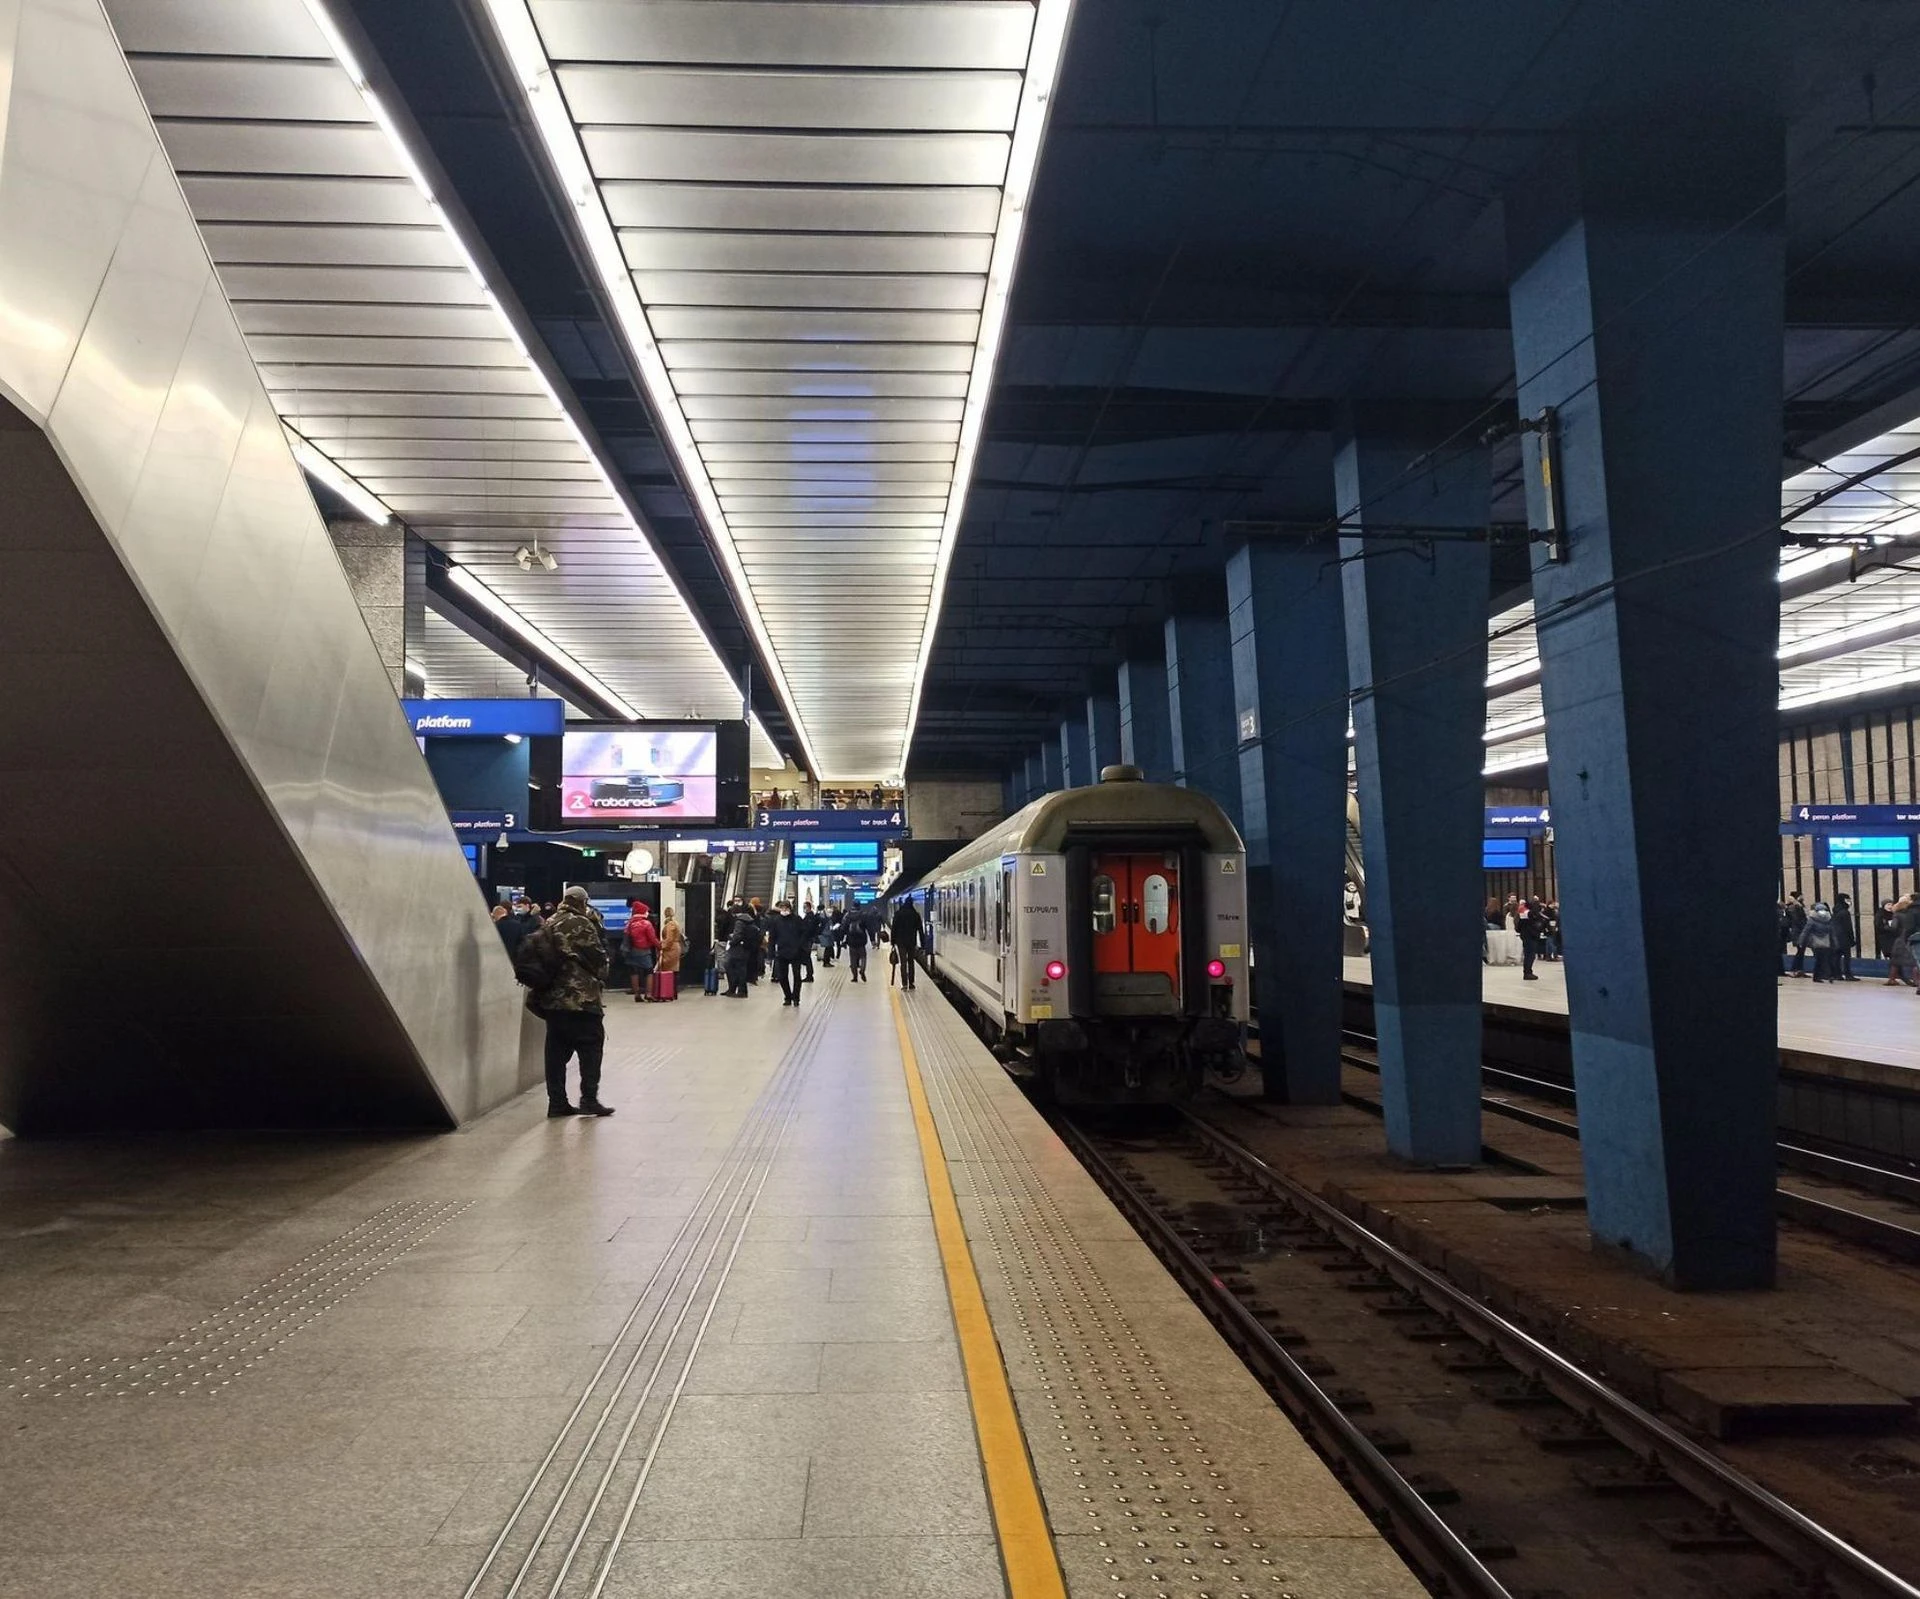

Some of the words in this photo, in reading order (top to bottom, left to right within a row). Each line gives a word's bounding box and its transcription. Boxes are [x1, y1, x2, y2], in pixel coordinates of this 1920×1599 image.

[416, 715, 472, 731] platform
[594, 798, 657, 807] roborock
[473, 820, 501, 829] platform
[504, 813, 515, 828] 3
[759, 812, 770, 826] 3
[772, 819, 791, 827] peron
[793, 818, 820, 827] platform
[872, 818, 887, 826] track
[890, 812, 901, 826] 4
[1539, 809, 1550, 823] 4
[1799, 807, 1810, 820] 4
[1831, 813, 1857, 821] platform
